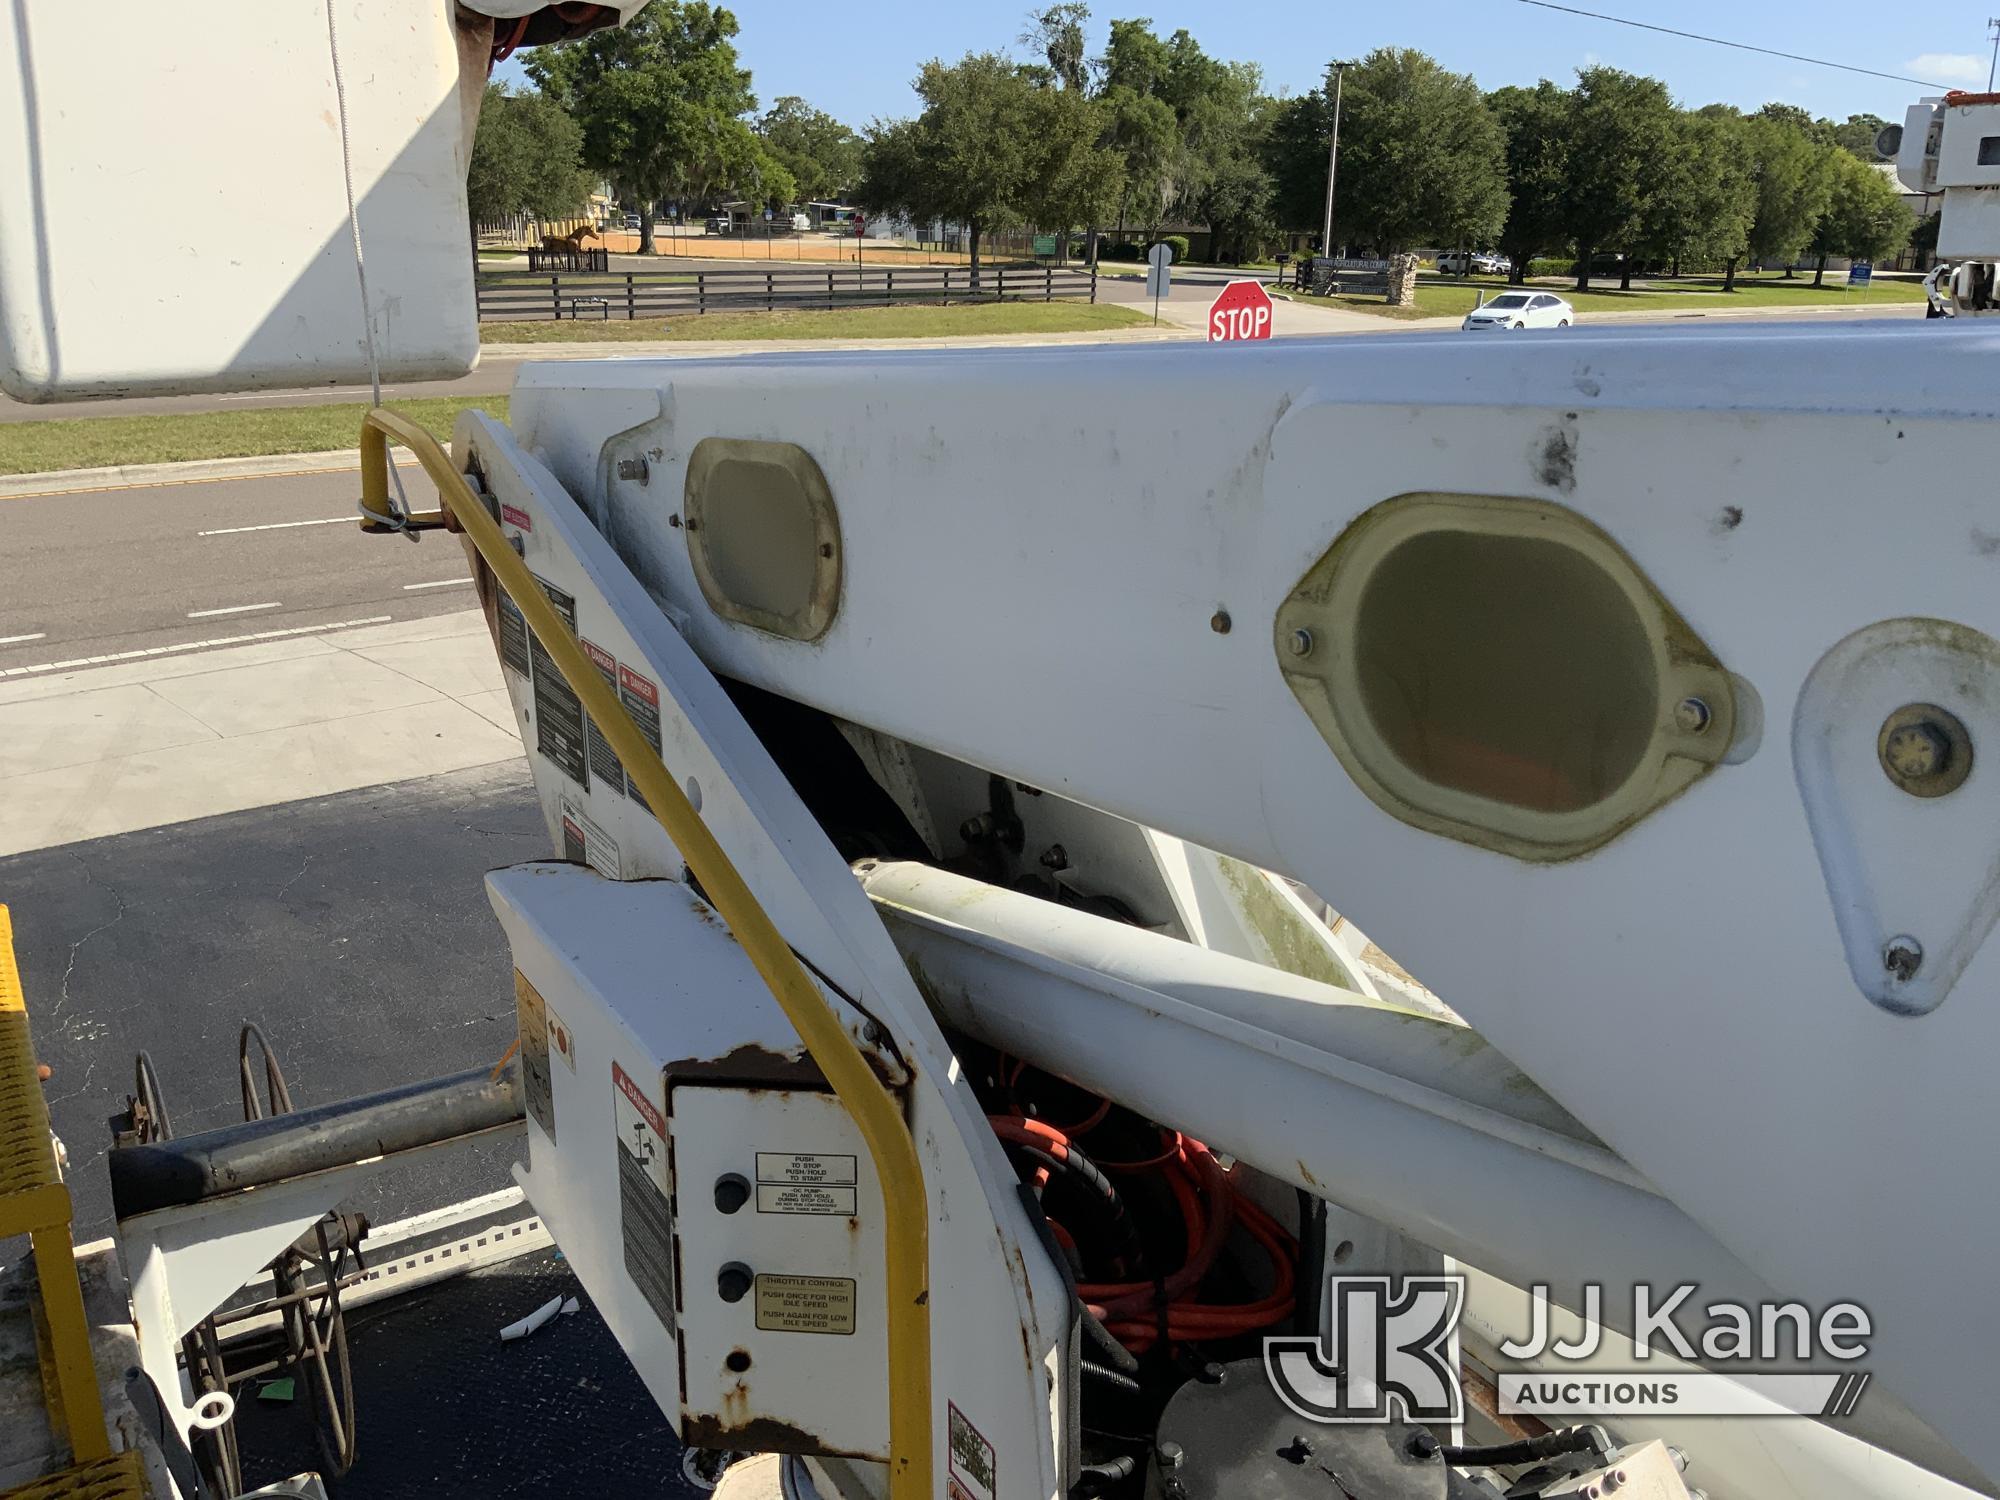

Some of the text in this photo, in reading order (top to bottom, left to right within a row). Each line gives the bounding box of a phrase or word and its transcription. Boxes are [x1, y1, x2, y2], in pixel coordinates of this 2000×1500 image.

[1212, 306, 1269, 342] STOP
[591, 647, 614, 672] DANGER
[630, 676, 653, 698] DANGER
[628, 1083, 658, 1129] DANGER
[786, 1292, 808, 1300] ONCE
[810, 1293, 826, 1301] FOR
[787, 1312, 810, 1320] AGAIN
[802, 1320, 828, 1328] SPEED
